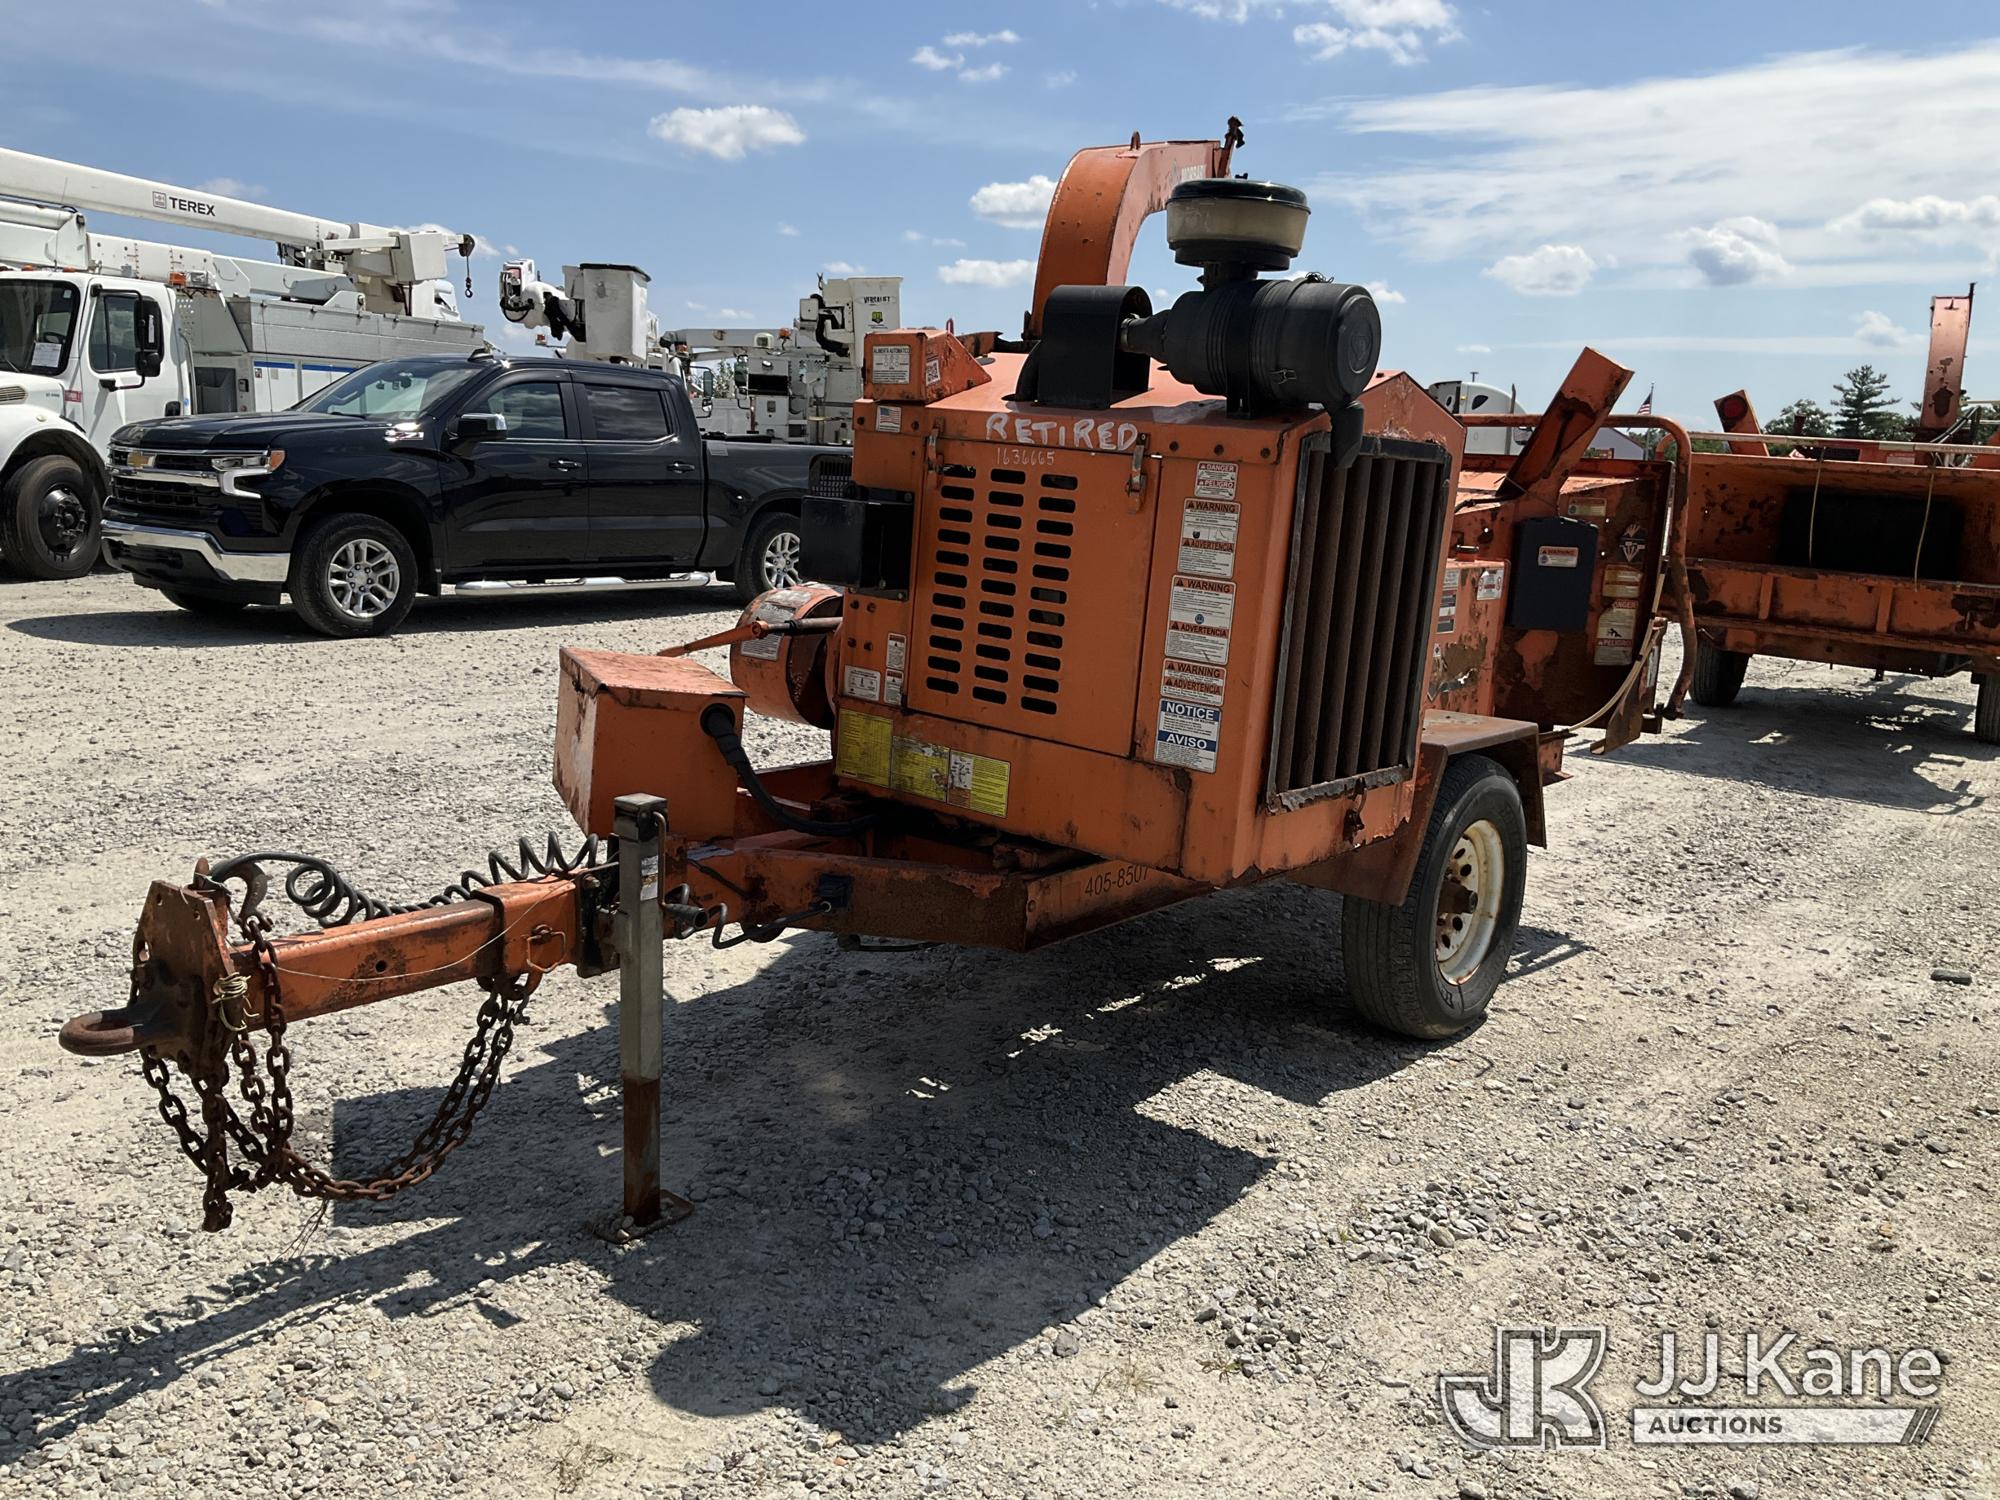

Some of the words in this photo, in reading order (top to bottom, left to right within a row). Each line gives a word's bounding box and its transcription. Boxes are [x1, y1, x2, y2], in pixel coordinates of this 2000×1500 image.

[169, 196, 216, 217] TEREX
[986, 412, 1138, 451] RETIRED
[1206, 463, 1235, 472] DANGER
[1204, 479, 1234, 489] PELIGRO
[1196, 501, 1236, 514] WARNING
[1190, 540, 1234, 552] ADVERTENCIA
[1187, 579, 1231, 594] WARNING
[1180, 622, 1227, 638] ADVERTENCIA
[1177, 663, 1221, 679] WARNING
[1174, 679, 1221, 695] ADVERTENCIA
[1166, 702, 1215, 721] NOTICE
[1166, 733, 1208, 750] AVISO
